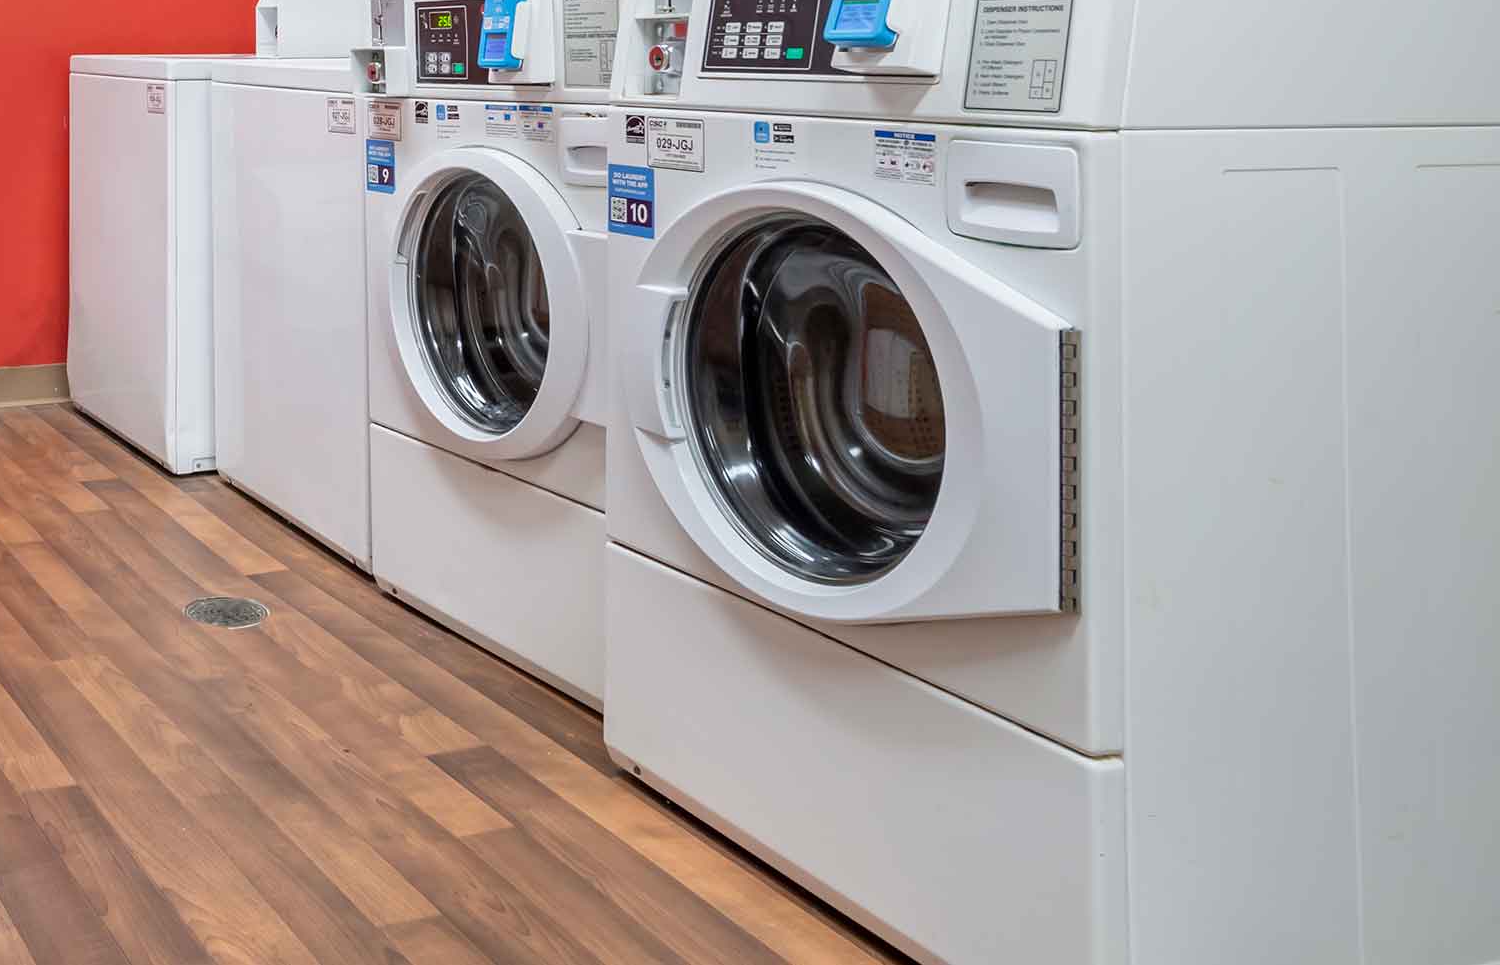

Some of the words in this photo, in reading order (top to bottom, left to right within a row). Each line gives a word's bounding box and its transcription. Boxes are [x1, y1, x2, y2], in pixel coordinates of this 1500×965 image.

[656, 138, 694, 152] 029-JGJ
[382, 167, 389, 184] 9
[629, 203, 648, 224] 10
